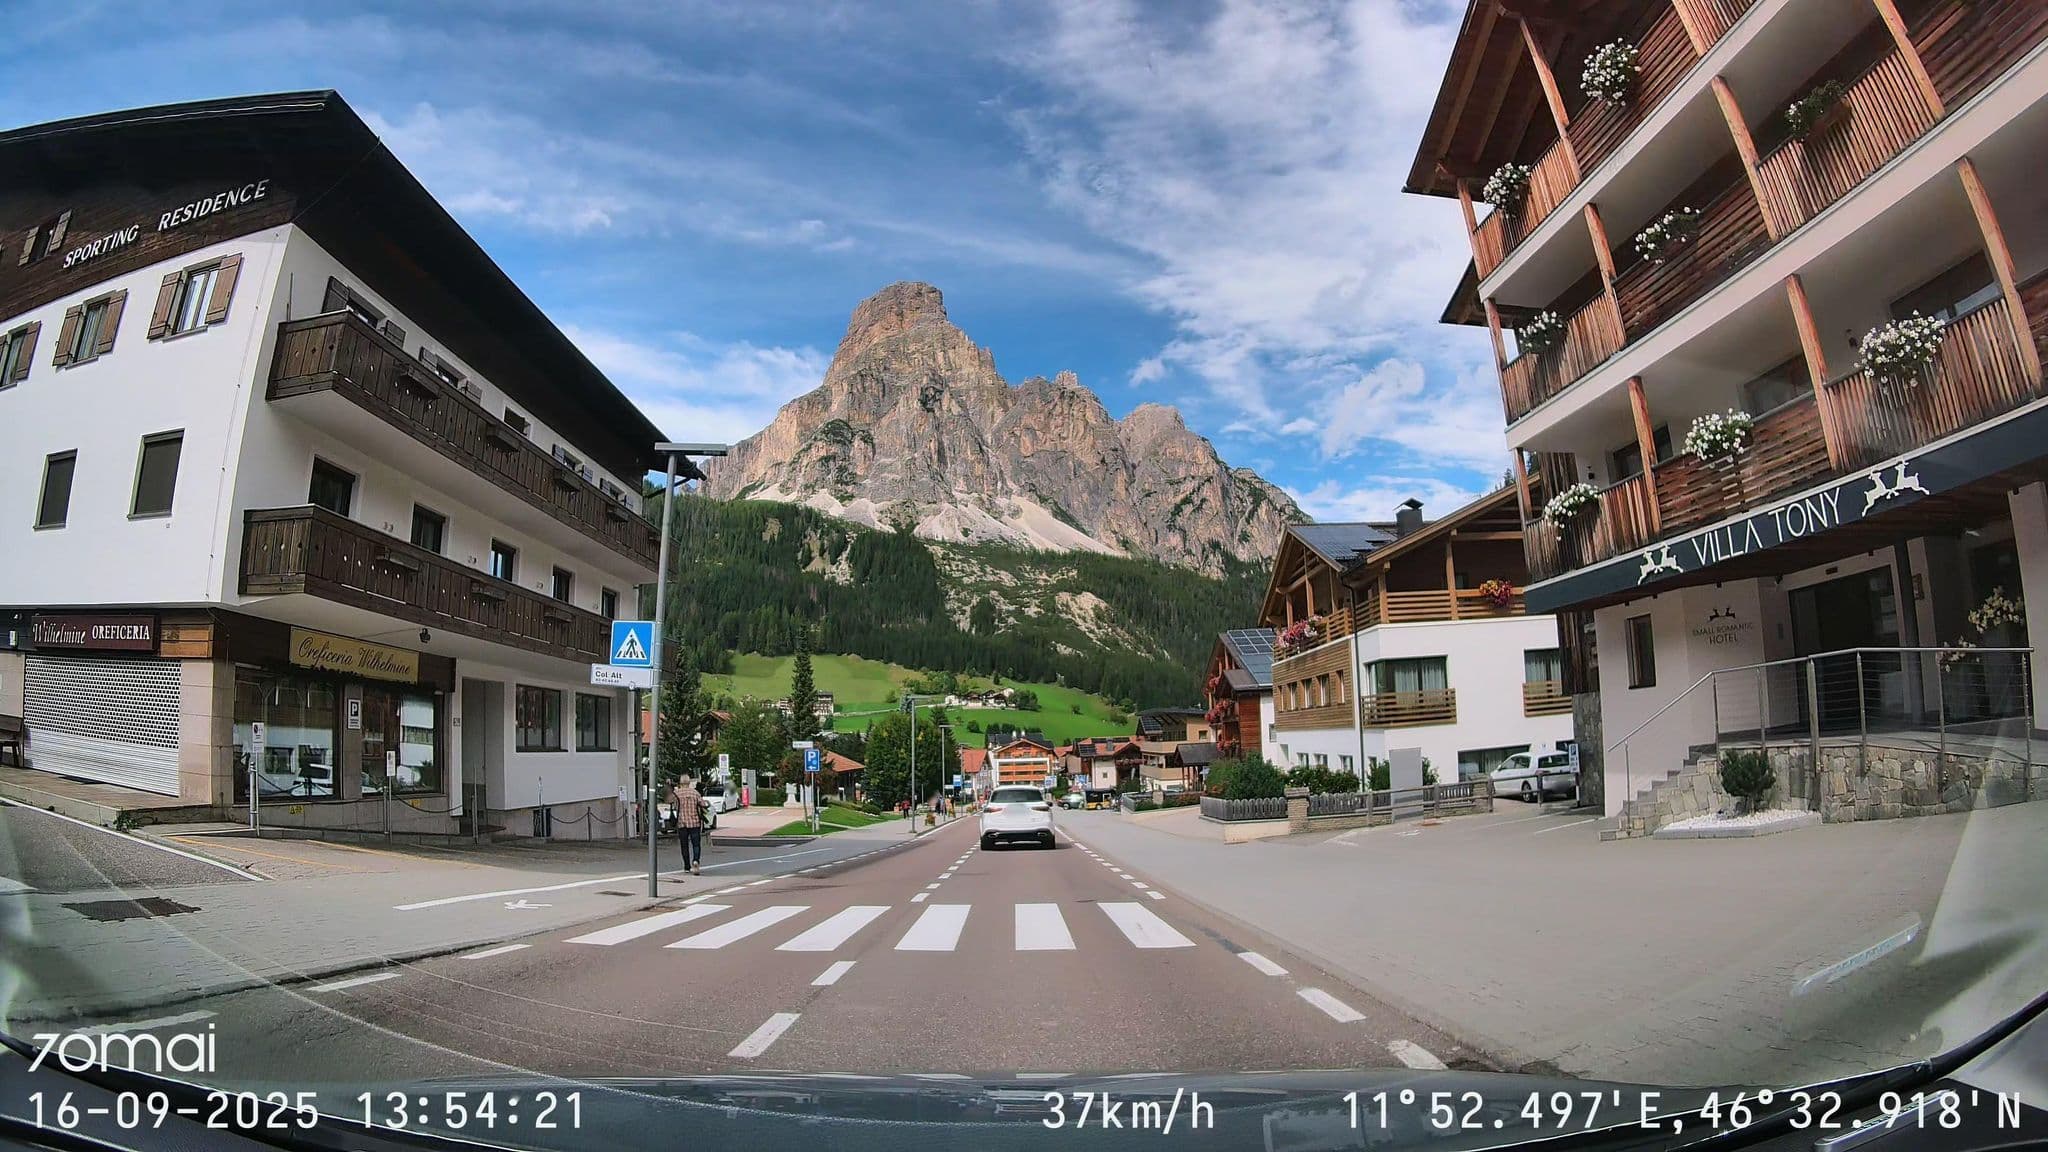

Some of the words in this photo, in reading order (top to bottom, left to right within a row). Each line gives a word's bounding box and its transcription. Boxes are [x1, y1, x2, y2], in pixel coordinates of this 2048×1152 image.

[63, 224, 139, 269] SPORTING
[158, 178, 270, 232] RESIDENCE
[1691, 519, 1763, 566] VILLA
[1768, 487, 1840, 543] TONY
[33, 620, 86, 644] Wilhelmine
[92, 625, 150, 640] OREFICERIA
[1709, 633, 1738, 645] HOTEL
[298, 636, 353, 668] Oreficeria
[358, 647, 411, 674] Wilhelmine
[595, 670, 608, 678] Col
[351, 703, 358, 715] P
[807, 751, 816, 762] P
